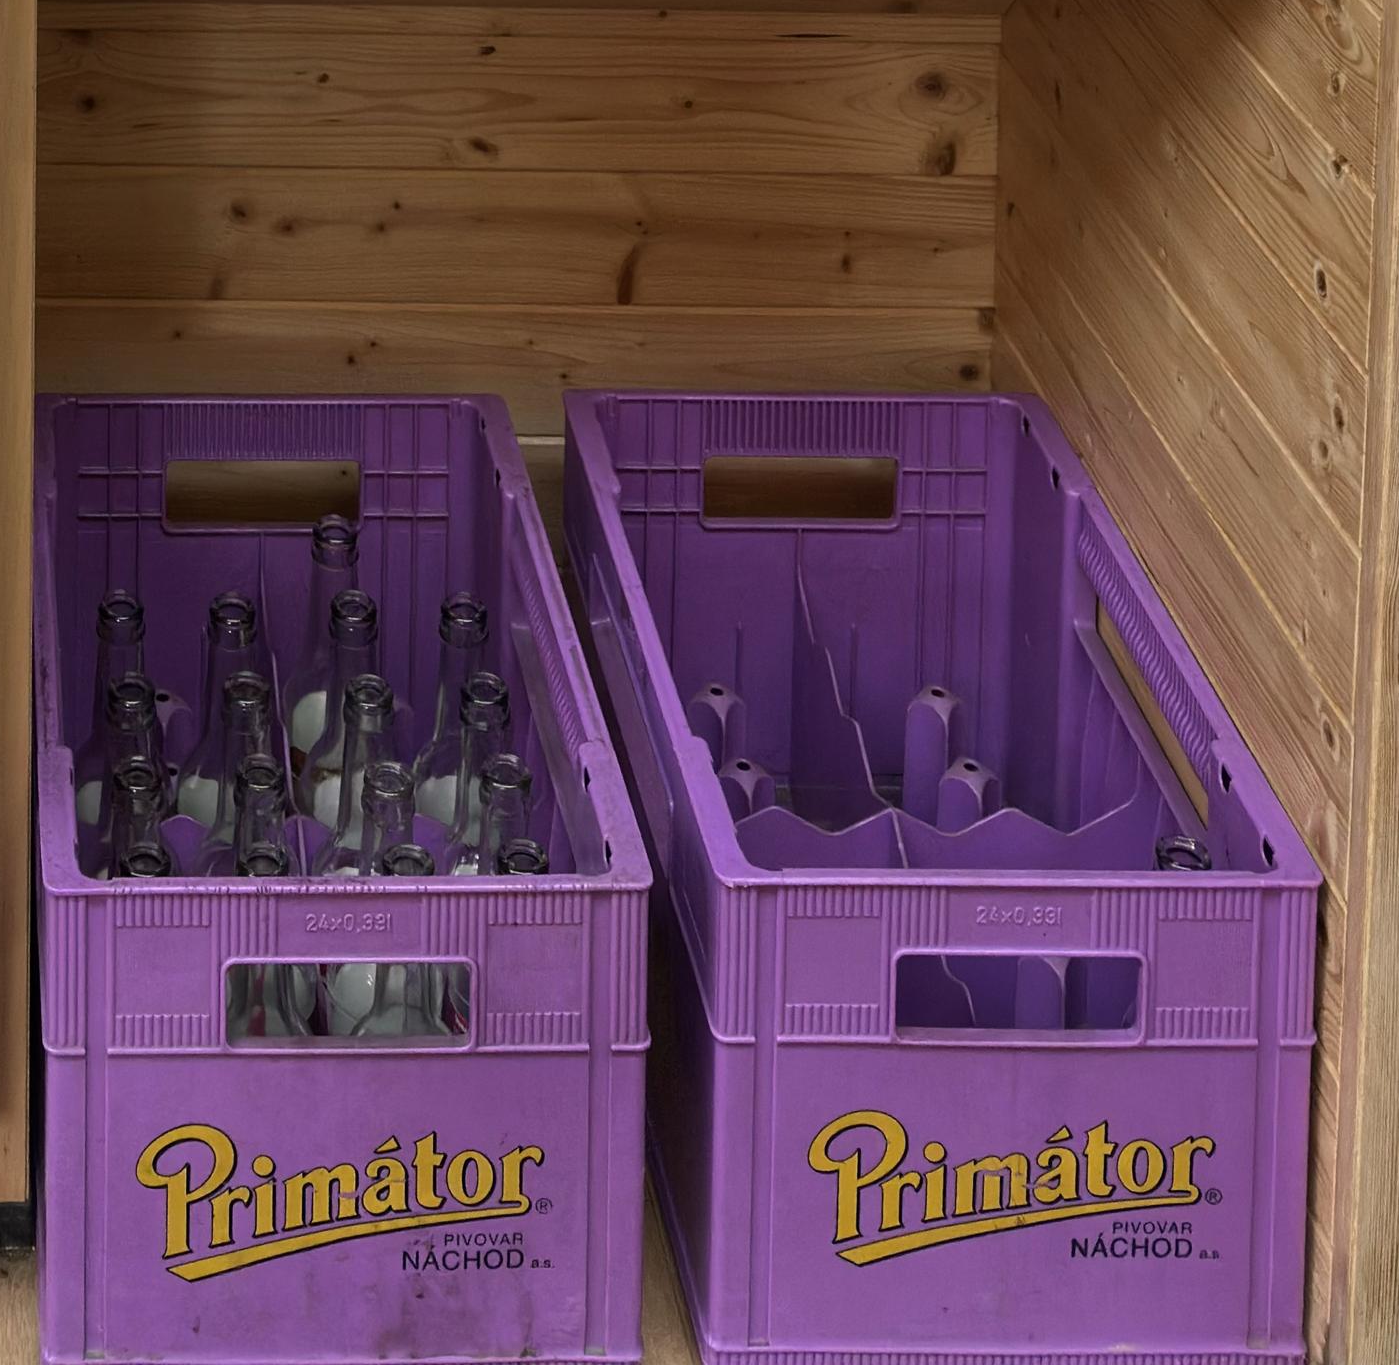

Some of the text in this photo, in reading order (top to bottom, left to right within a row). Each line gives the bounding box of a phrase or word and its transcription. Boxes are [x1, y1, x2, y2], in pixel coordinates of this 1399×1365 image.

[135, 1123, 544, 1260] Primátor
[444, 1234, 524, 1246] PIVOVAR
[402, 1245, 524, 1270] NÁCHOD
